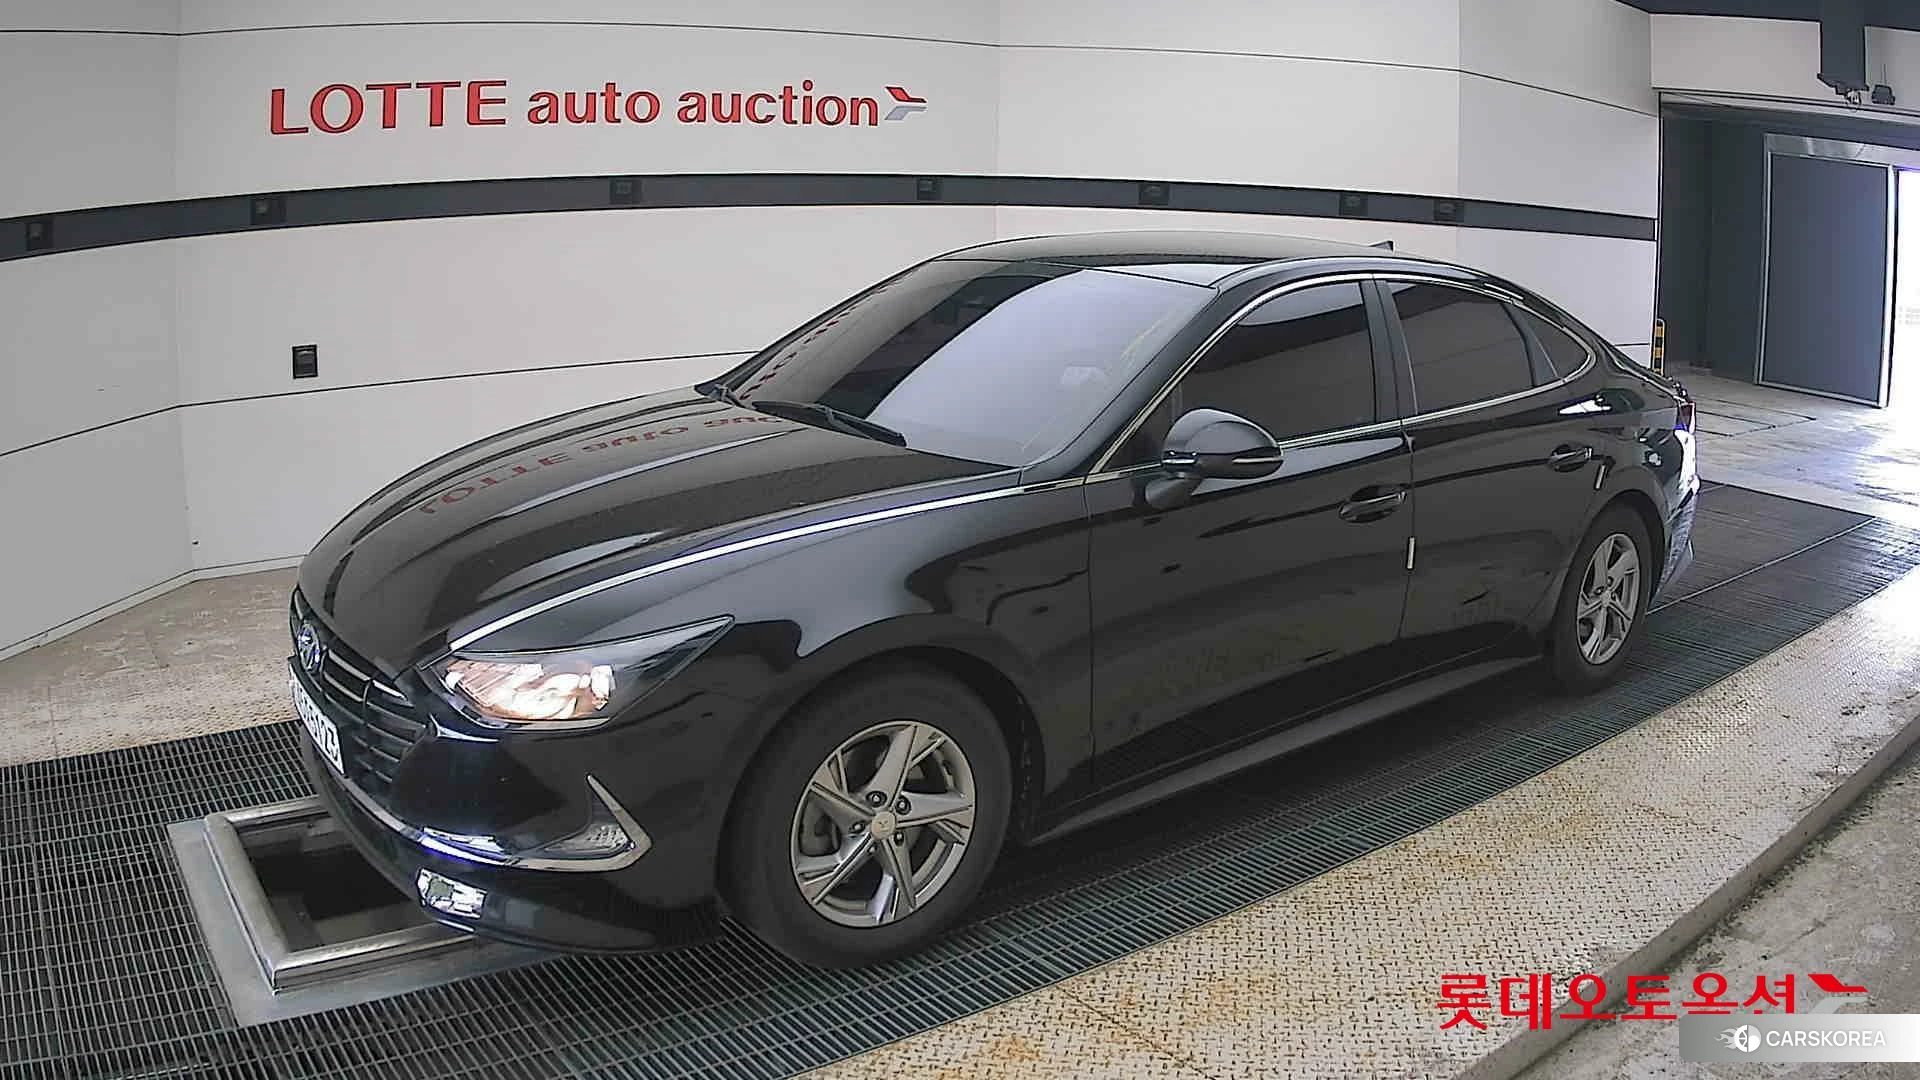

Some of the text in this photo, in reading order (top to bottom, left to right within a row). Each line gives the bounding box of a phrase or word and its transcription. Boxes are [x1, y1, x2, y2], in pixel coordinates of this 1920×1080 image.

[269, 79, 880, 136] LOTTE auto auction
